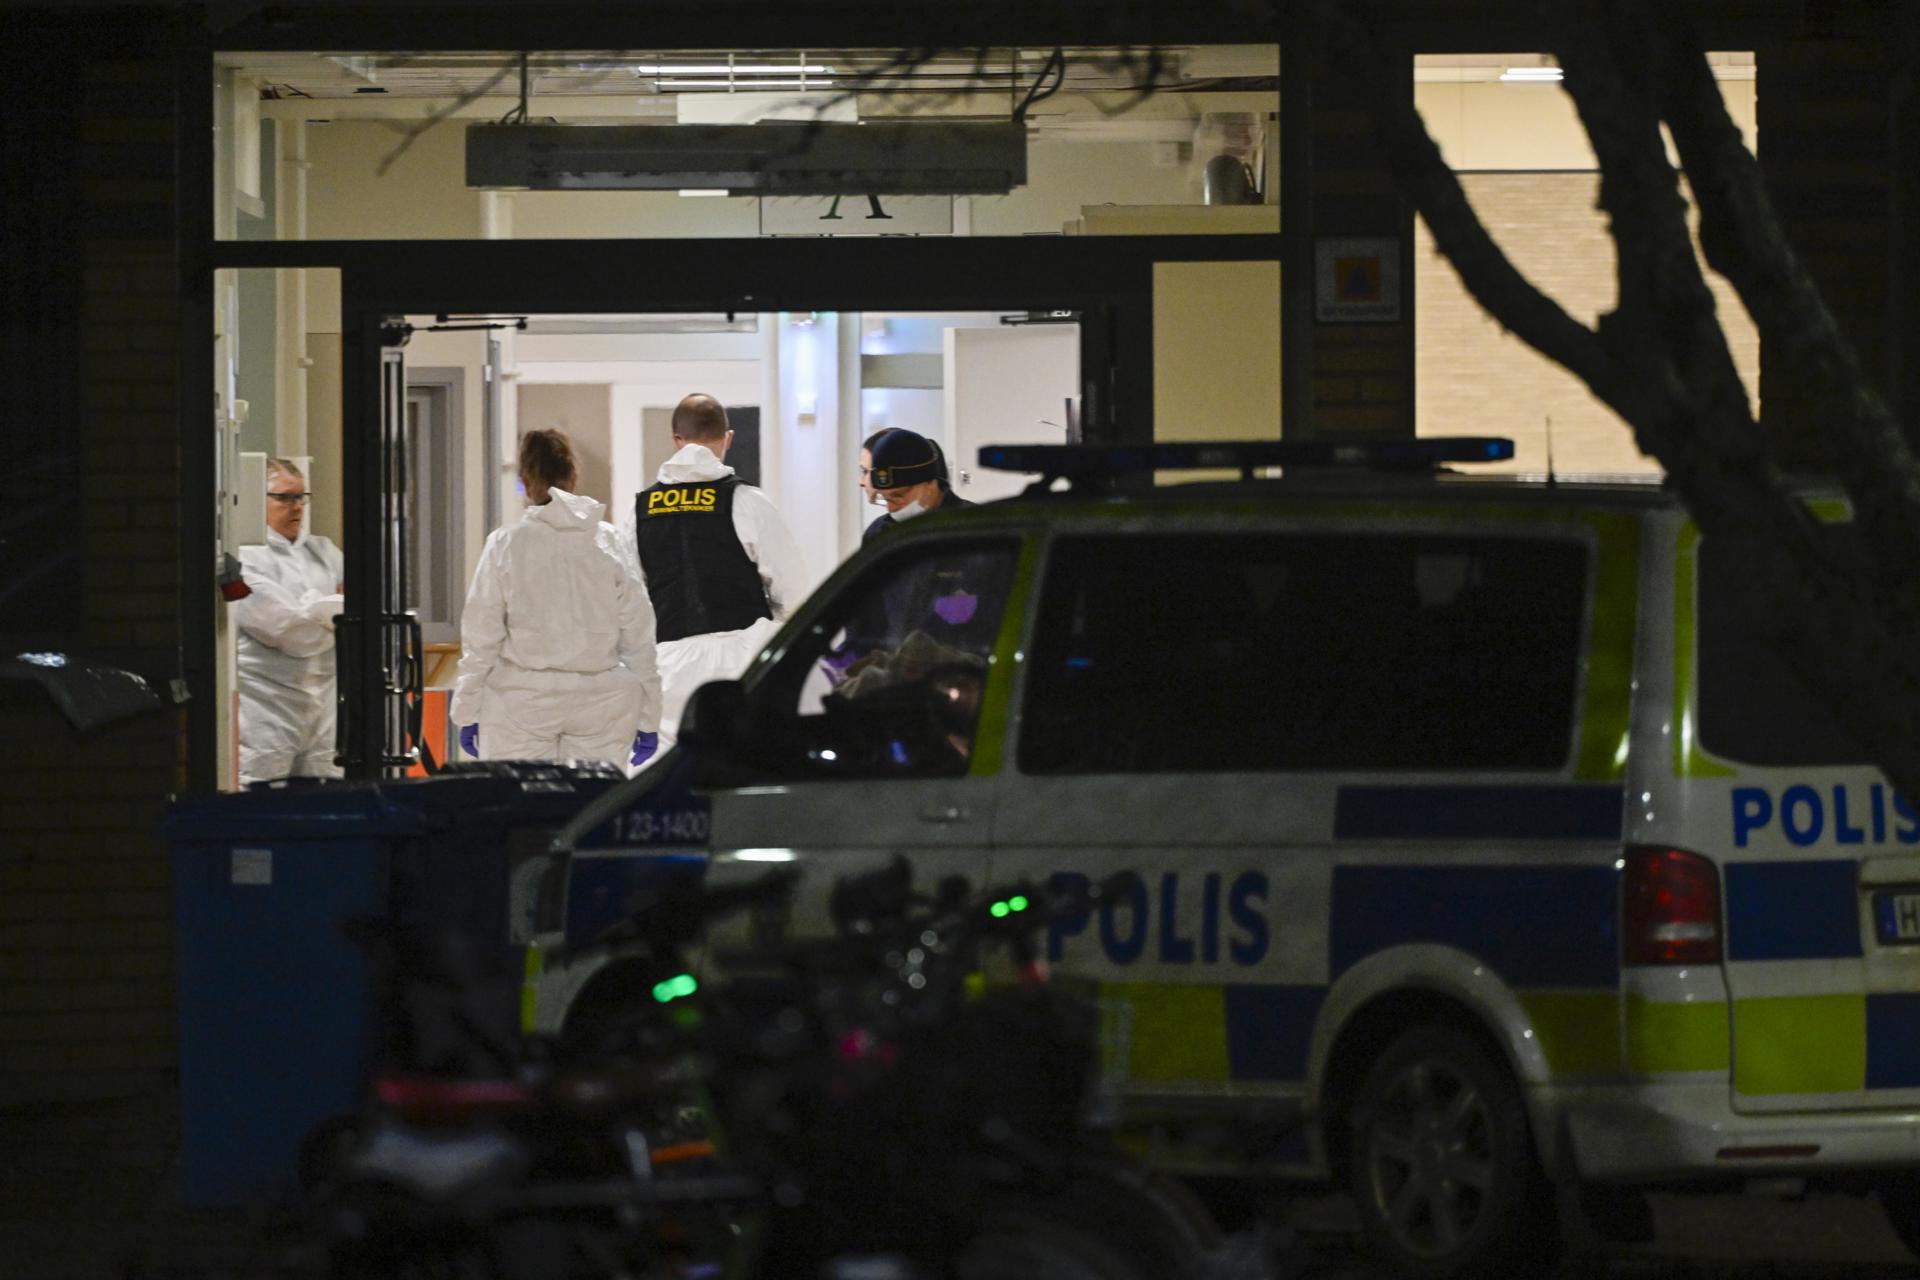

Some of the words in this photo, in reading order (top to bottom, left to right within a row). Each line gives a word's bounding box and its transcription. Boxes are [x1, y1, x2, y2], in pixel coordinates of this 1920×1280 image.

[648, 488, 717, 508] POLIS
[1732, 784, 1920, 846] POLIS
[1048, 870, 1269, 966] POLIS
